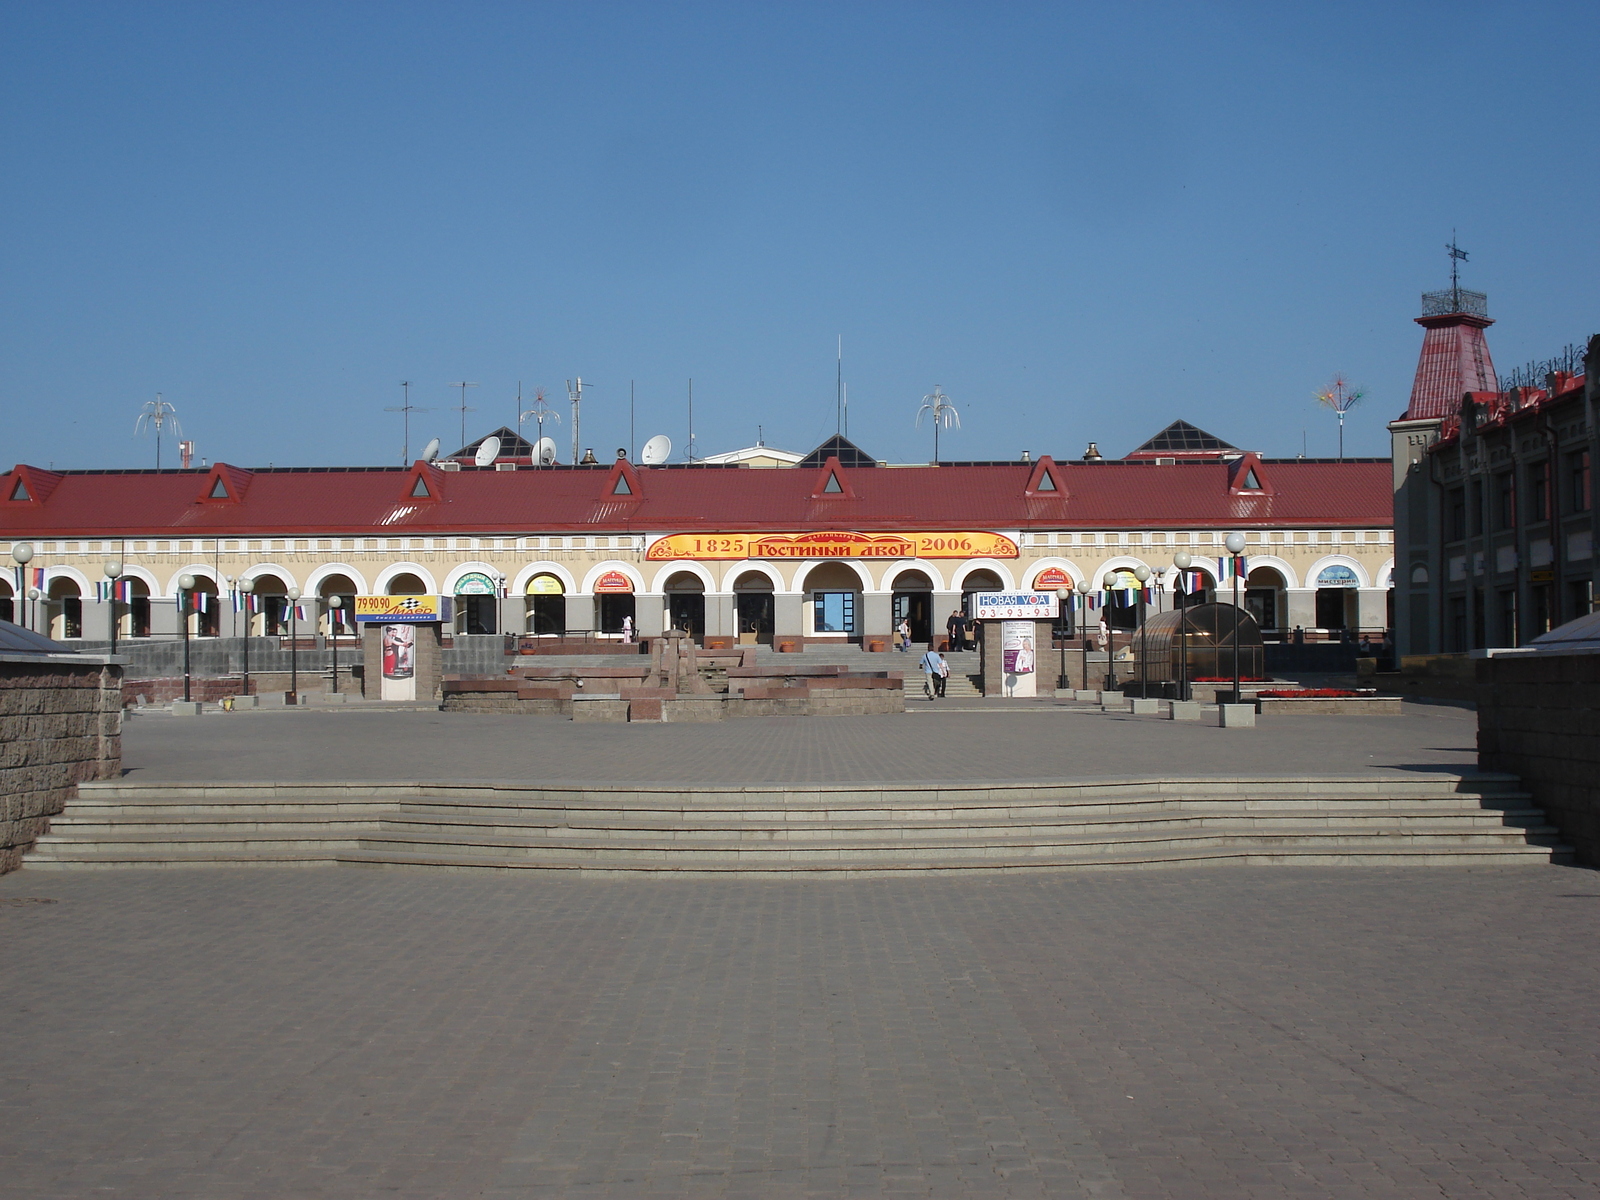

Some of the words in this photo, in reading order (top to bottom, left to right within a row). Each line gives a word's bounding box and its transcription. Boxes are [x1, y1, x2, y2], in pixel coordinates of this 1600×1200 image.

[693, 539, 744, 553] 1825
[921, 538, 972, 551] 2006
[982, 596, 1018, 605] НОВАЯ
[383, 605, 432, 615] Лидер
